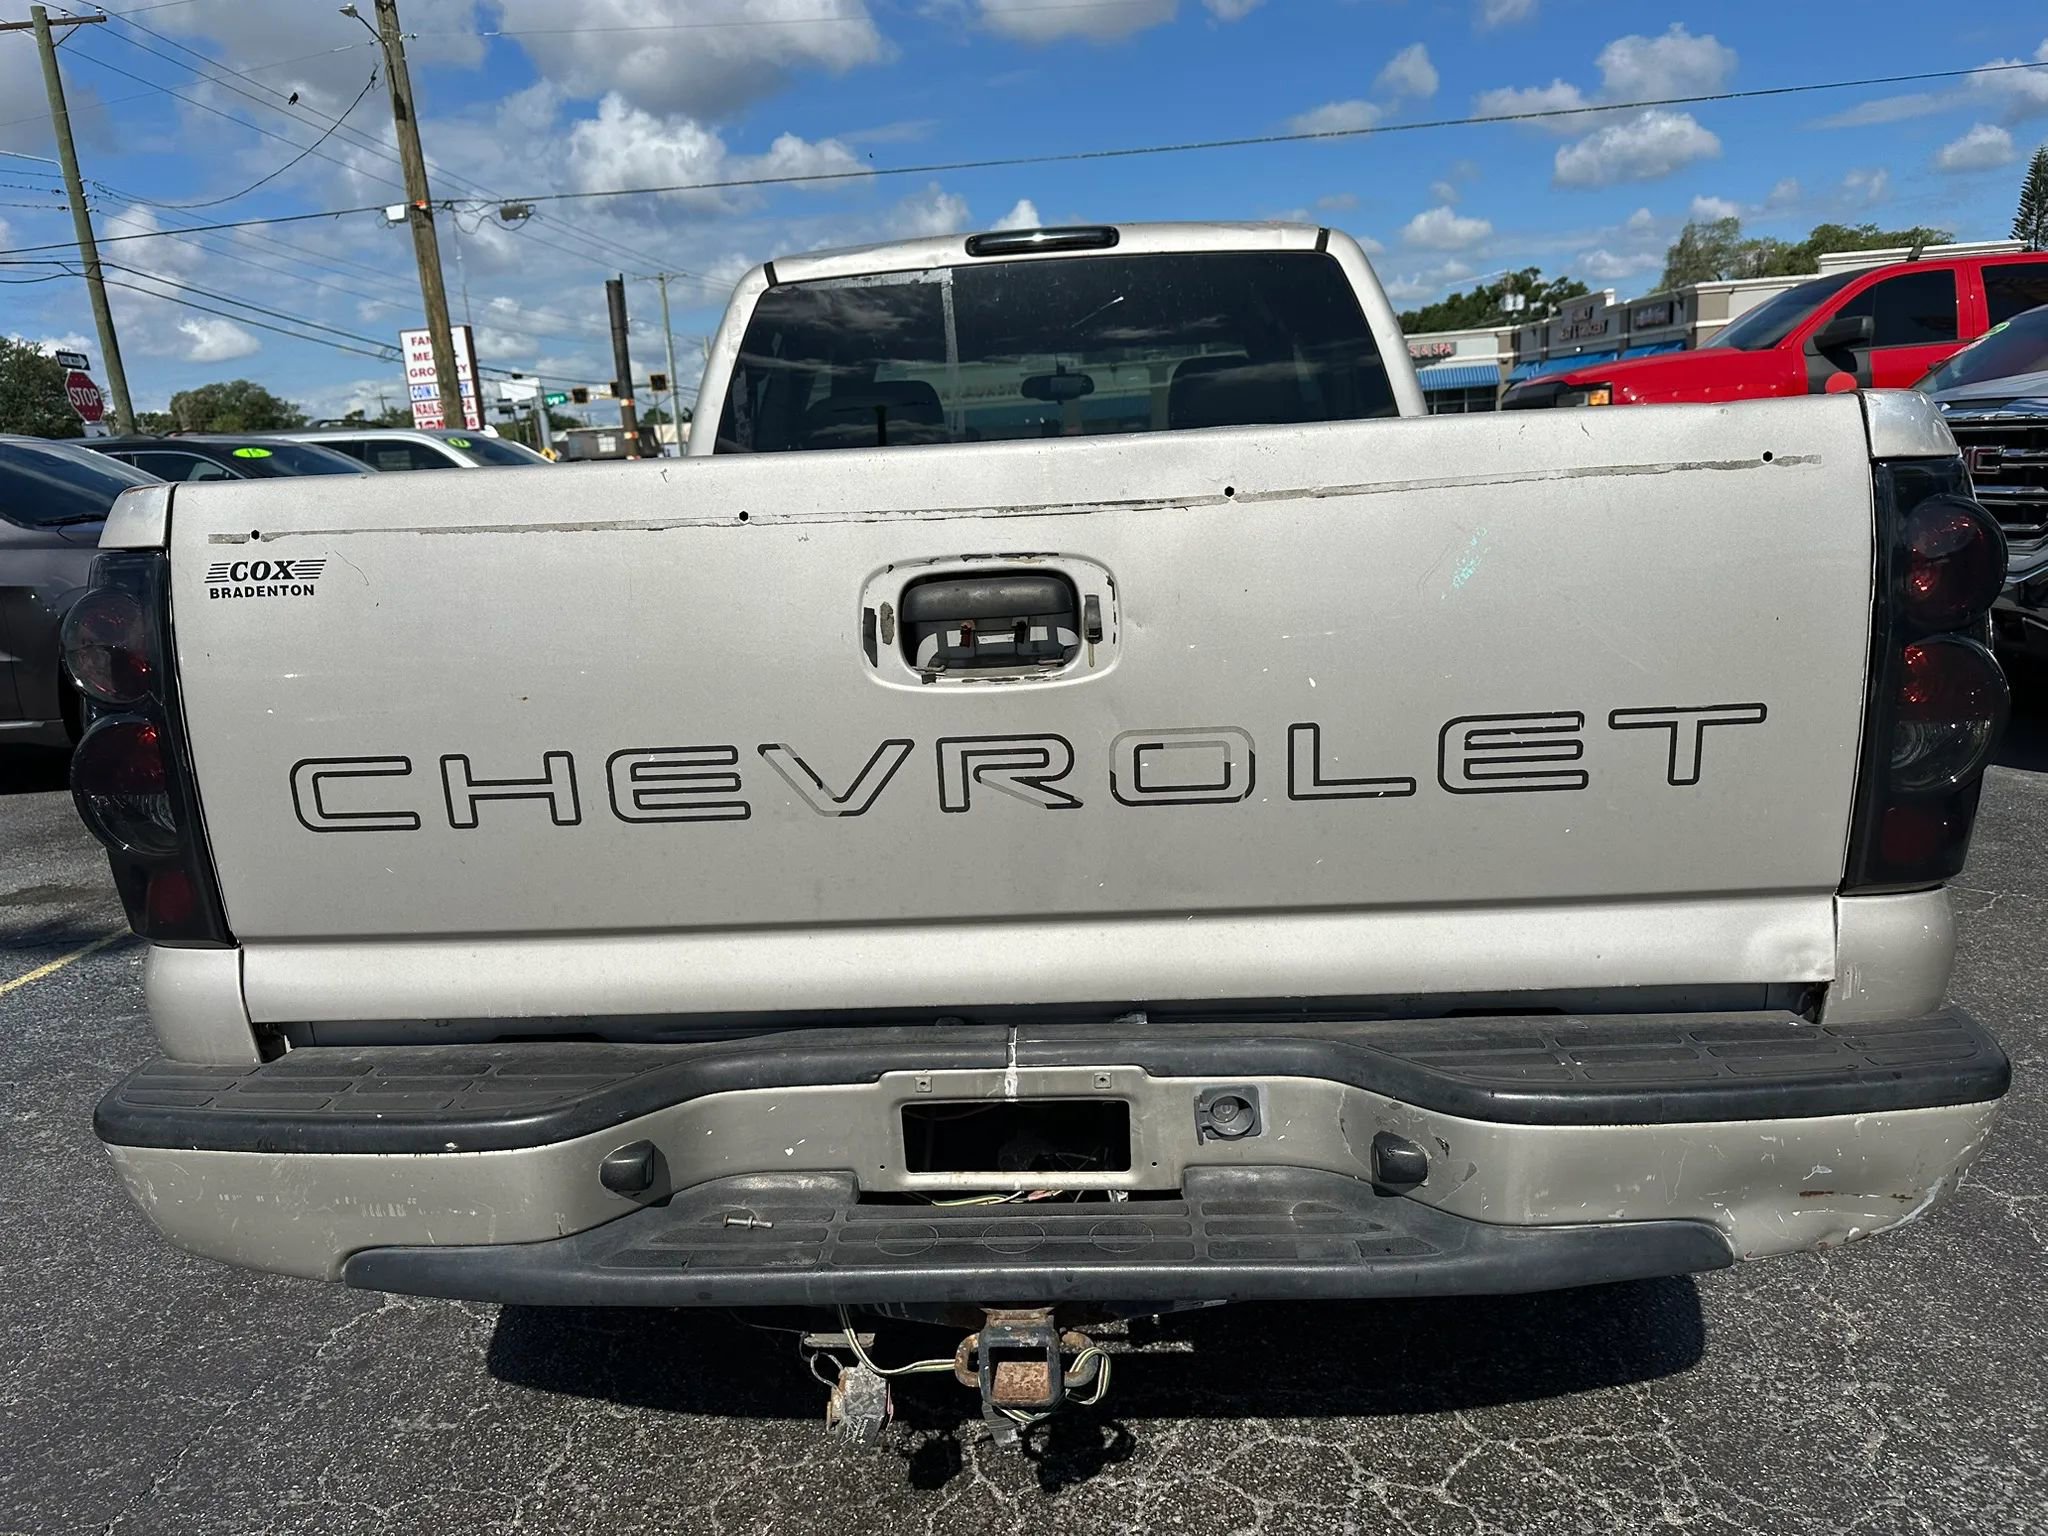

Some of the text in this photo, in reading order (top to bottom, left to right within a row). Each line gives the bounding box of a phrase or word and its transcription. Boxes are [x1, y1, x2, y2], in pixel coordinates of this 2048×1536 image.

[1432, 342, 1453, 357] SPA
[69, 387, 99, 407] STOP
[229, 560, 297, 582] COX
[209, 584, 315, 599] BRADENTON
[290, 702, 1767, 832] CHEVROLET
